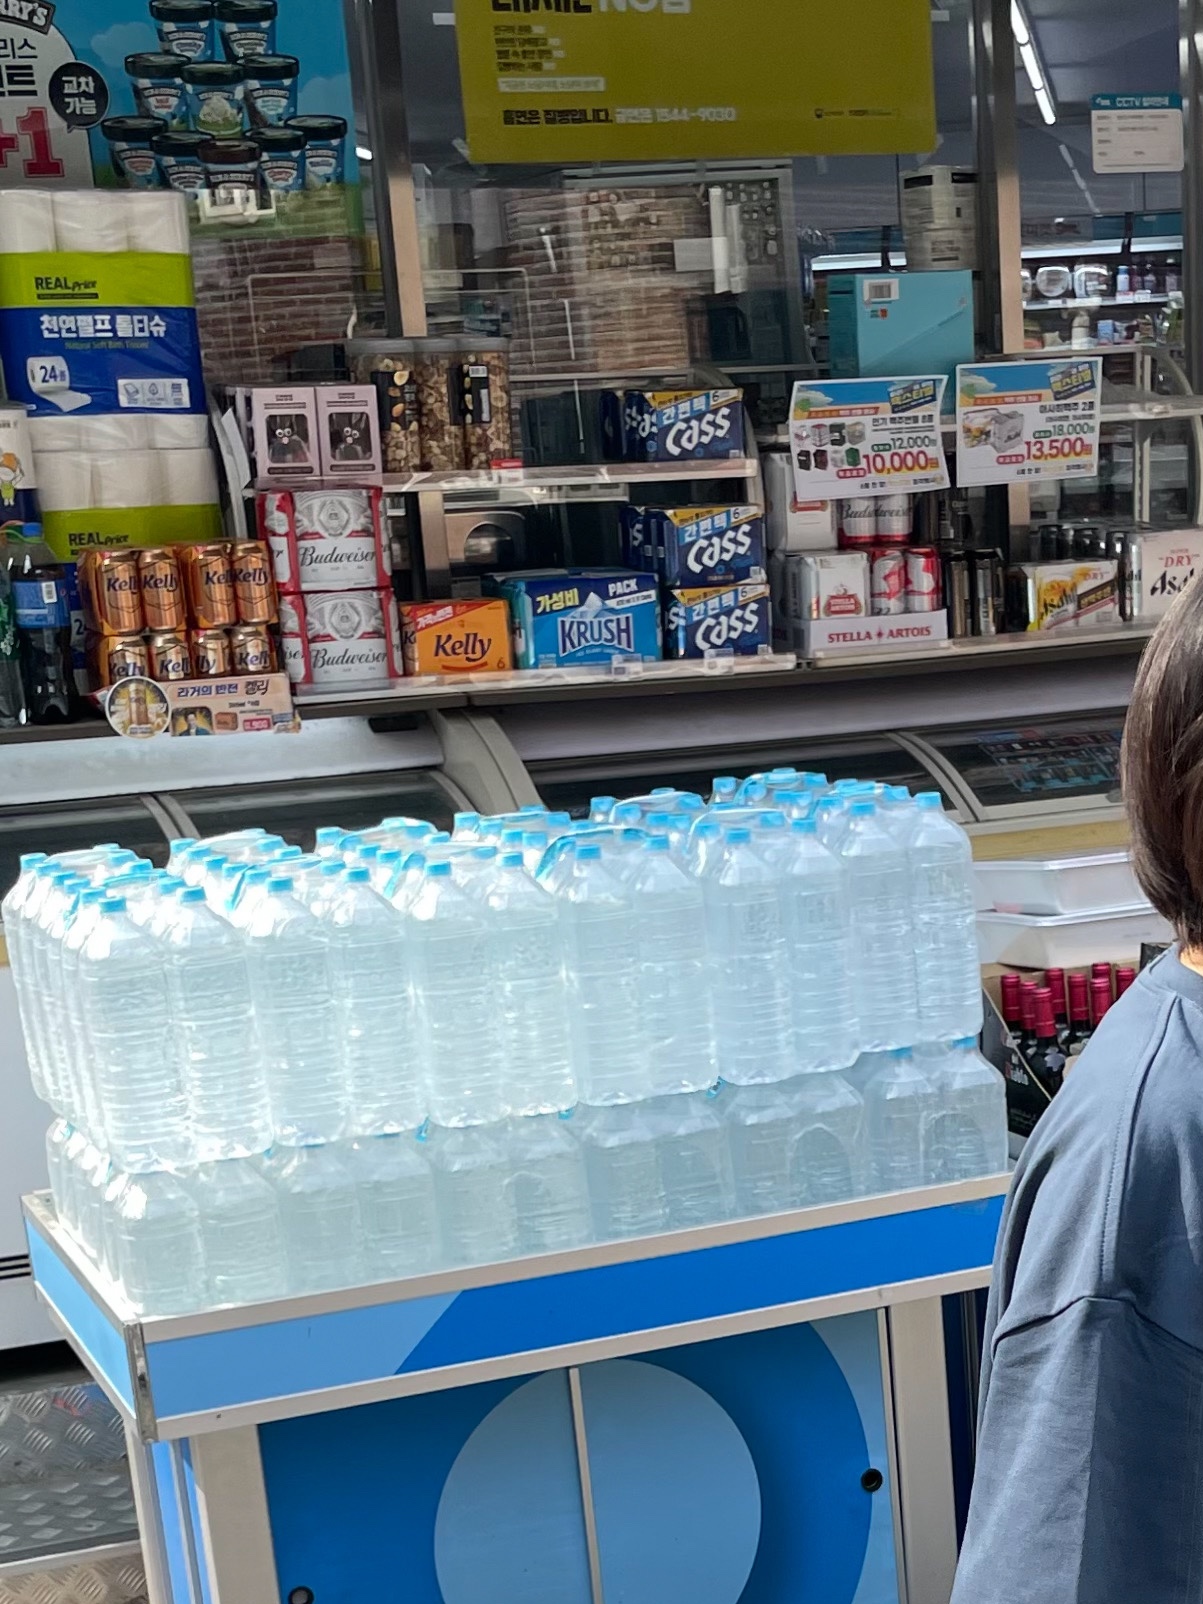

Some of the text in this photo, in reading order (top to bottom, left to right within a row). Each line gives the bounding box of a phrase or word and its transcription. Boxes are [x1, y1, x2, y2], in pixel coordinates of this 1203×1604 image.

[0, 65, 38, 97] 트
[61, 76, 96, 94] 교차
[64, 97, 97, 115] 가능
[1116, 97, 1141, 107] CCTV
[35, 277, 71, 291] REAL
[40, 314, 167, 338] 천연펄프 롤티슈
[712, 390, 720, 402] 6
[733, 508, 741, 519] 6
[68, 532, 104, 547] REAL
[299, 546, 377, 568] Budweiser
[1163, 554, 1194, 568] DRY
[608, 578, 639, 597] PACK
[740, 587, 748, 598] 6
[536, 587, 580, 614] 가성비
[558, 614, 634, 657] KRUSH
[827, 625, 932, 644] STELLA ARTOIS
[433, 632, 492, 663] Kelly
[312, 648, 388, 671] Budweiser
[497, 656, 505, 670] 6
[177, 685, 212, 698] 라거의
